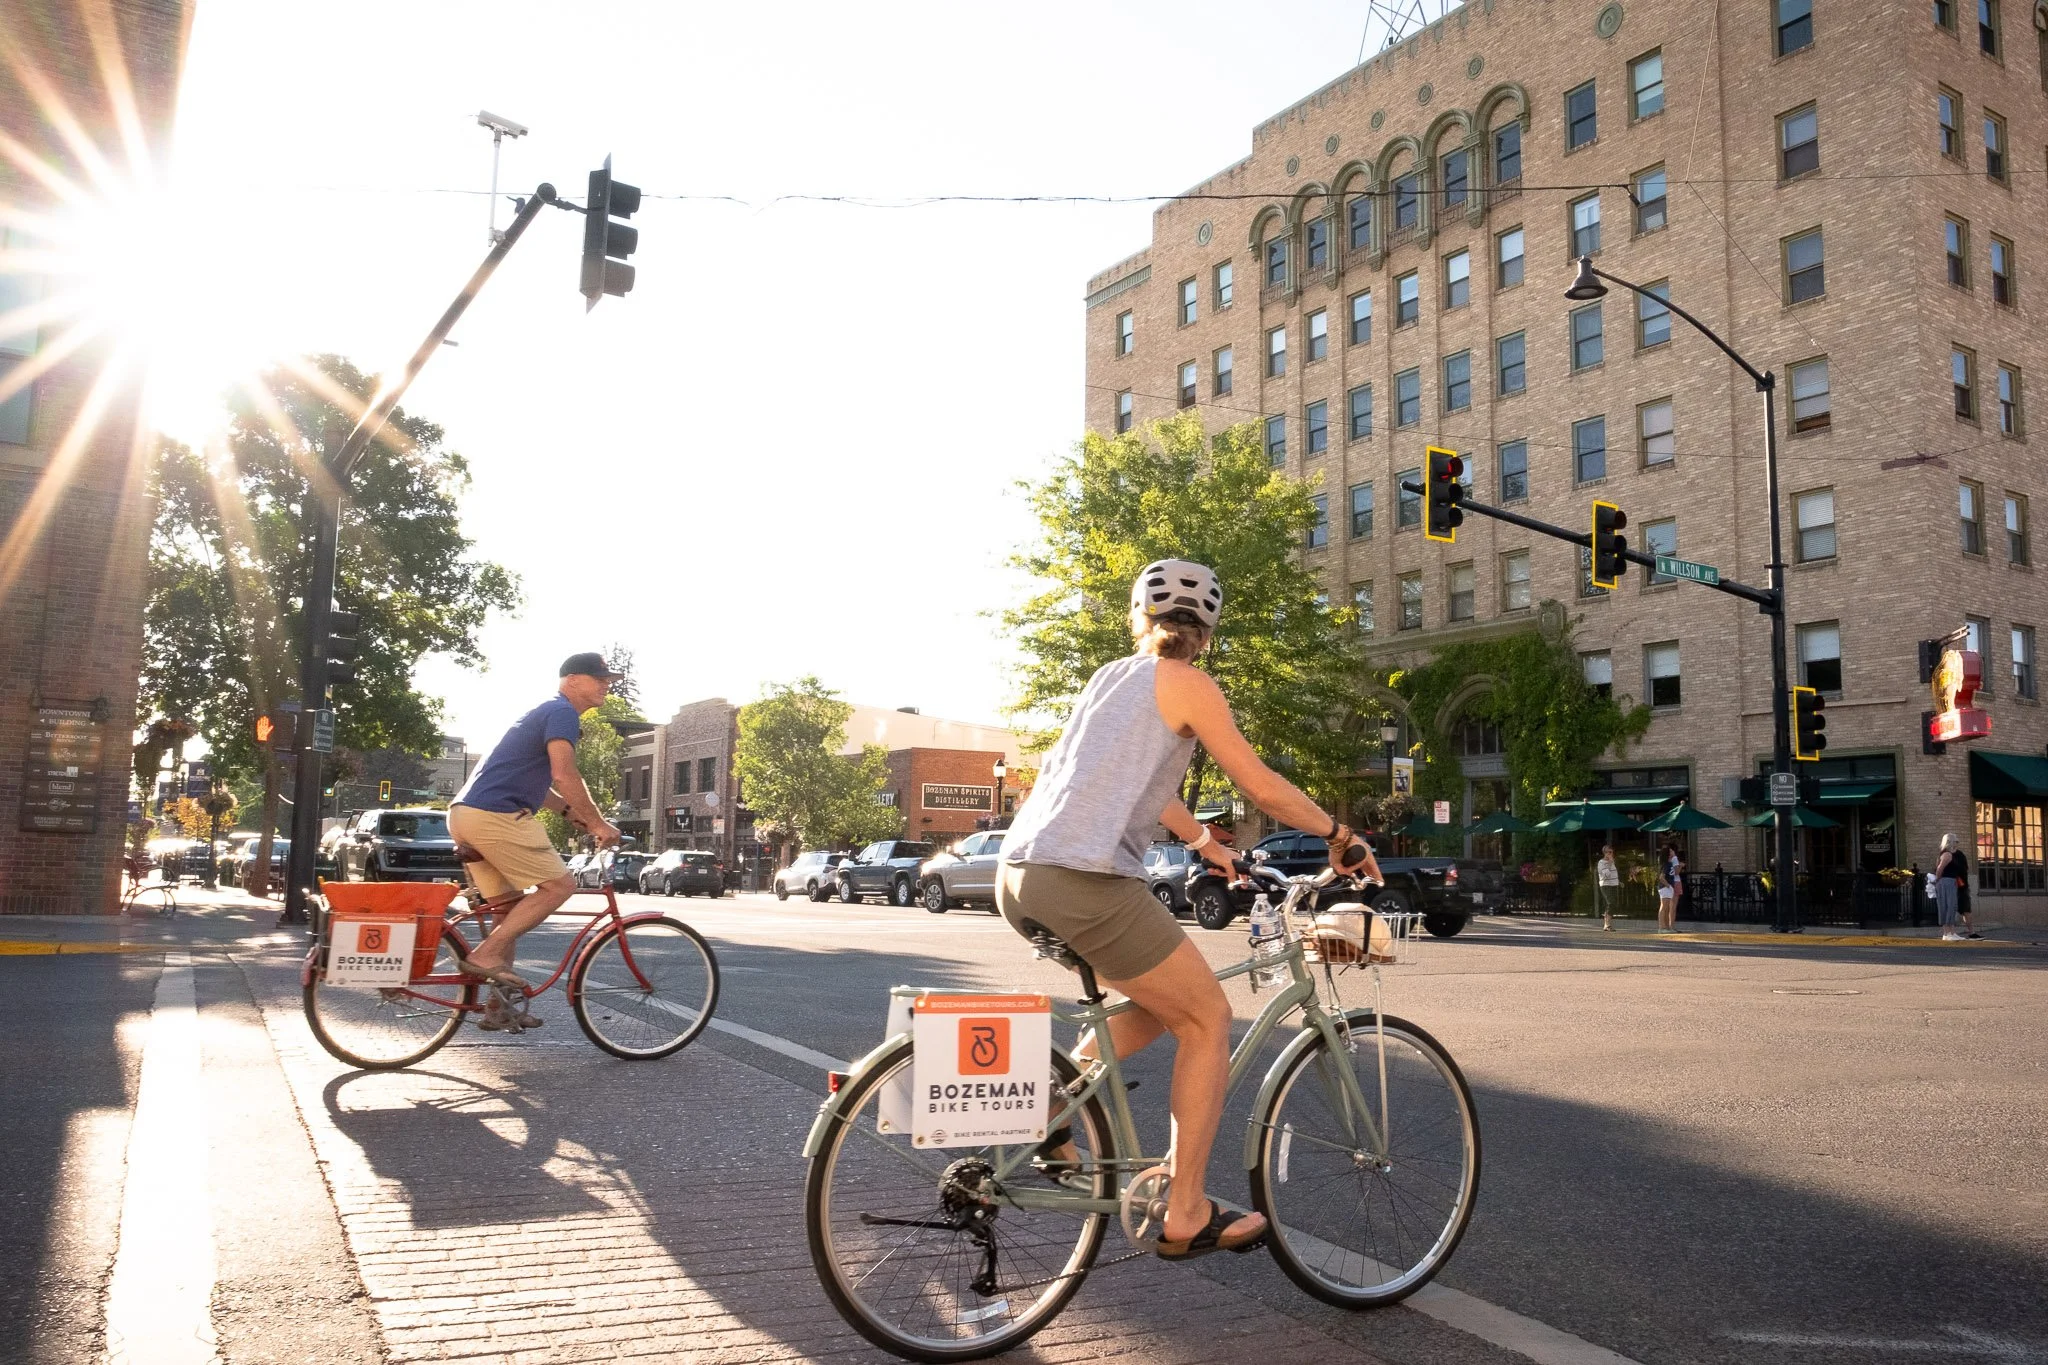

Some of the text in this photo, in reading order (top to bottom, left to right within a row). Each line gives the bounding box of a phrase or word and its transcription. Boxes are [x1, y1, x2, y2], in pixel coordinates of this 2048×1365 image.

[1661, 560, 1714, 582] N WILLSON AVE
[48, 718, 87, 727] BUILDING
[925, 786, 990, 797] BOZEMAN SPIRITS
[935, 796, 979, 805] DISTILLERY
[338, 956, 404, 965] BOZEMAN
[929, 1081, 1036, 1100] BOZEMAN
[928, 1099, 1035, 1113] BIKE TOURS
[1000, 1128, 1031, 1136] PARTNER
